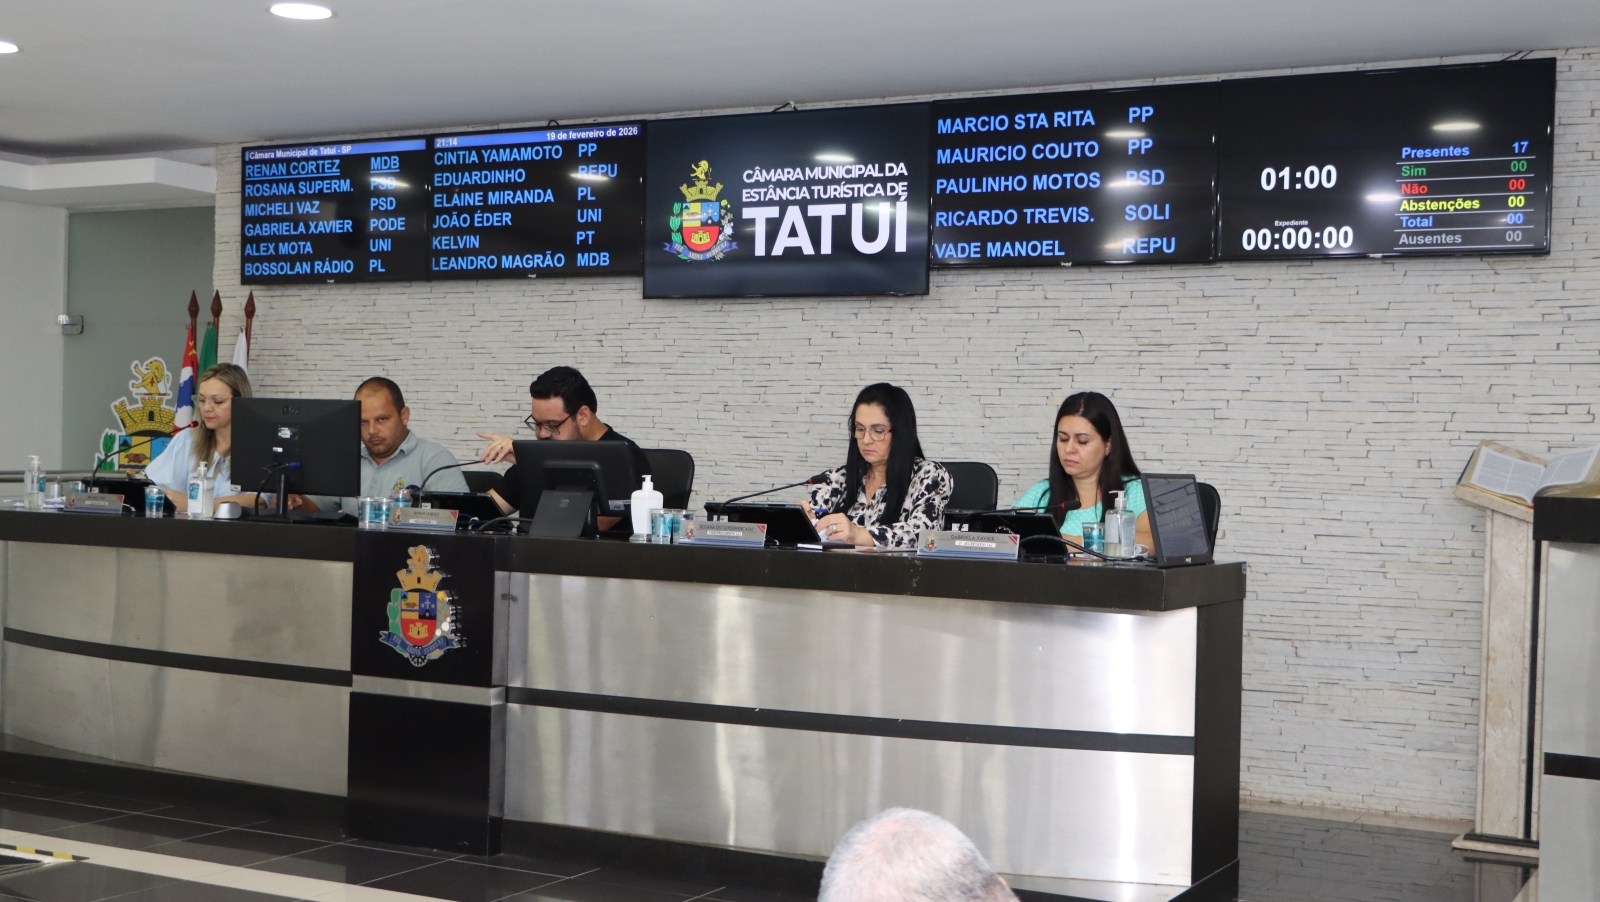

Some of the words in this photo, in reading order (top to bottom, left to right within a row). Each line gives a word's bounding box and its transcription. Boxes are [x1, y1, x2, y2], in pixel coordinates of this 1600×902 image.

[938, 114, 1008, 134] MARCIO
[1014, 113, 1048, 130] STA
[1054, 110, 1095, 128] RITA
[1128, 106, 1154, 123] PP
[436, 138, 458, 146] 21:14
[546, 132, 556, 140] 19
[558, 131, 568, 140] de
[569, 129, 604, 139] fevereiro
[606, 128, 616, 136] de
[618, 127, 638, 136] 2026
[250, 151, 274, 160] Câmara
[276, 148, 308, 158] Municipal
[342, 146, 352, 154] SP
[434, 151, 478, 165] CINTIA
[482, 145, 562, 162] YAMAMOTO
[578, 144, 597, 157] PP
[936, 145, 1026, 164] MAURICIO
[1032, 142, 1098, 160] COUTO
[1128, 138, 1153, 154] PP
[1402, 146, 1470, 158] Presentes
[1512, 142, 1528, 153] 17
[246, 163, 286, 178] RENAN
[290, 160, 340, 174] CORTEZ
[371, 156, 400, 170] MDB
[434, 168, 526, 186] EDUARDINHO
[578, 164, 618, 178] REPU
[743, 166, 803, 182] CÂMARA
[806, 164, 884, 180] MUNICIPAL
[886, 162, 908, 176] DA
[1402, 166, 1426, 176] Sim
[1510, 160, 1527, 172] 00
[246, 183, 296, 196] ROSANA
[298, 179, 354, 194] SUPERM.
[370, 176, 396, 190] PSD
[936, 176, 1027, 194] PAULINHO
[1033, 172, 1100, 190] MOTOS
[1126, 170, 1164, 186] PSD
[1260, 165, 1336, 190] 01:00
[1402, 184, 1428, 194] Não
[1509, 179, 1526, 190] 00
[434, 192, 483, 207] ELAINE
[488, 189, 554, 205] MIRANDA
[578, 187, 596, 200] PL
[742, 184, 810, 202] ESTÂNCIA
[812, 181, 884, 199] TURÍSTICA
[886, 182, 908, 196] DE
[245, 202, 294, 216] MICHELI
[296, 201, 320, 214] VAZ
[370, 198, 396, 210] PSD
[1400, 198, 1480, 212] Abstenções
[1508, 196, 1524, 208] 00
[432, 212, 470, 228] JOÃO
[474, 210, 512, 226] ÉDER
[578, 209, 602, 222] UNI
[936, 209, 1018, 226] RICARDO
[1024, 206, 1094, 224] TREVIS.
[1125, 204, 1170, 220] SOLI
[1400, 216, 1432, 228] Total
[1507, 214, 1524, 224] 00
[245, 223, 306, 236] GABRIELA
[308, 220, 352, 234] XAVIER
[370, 218, 406, 231] PODE
[742, 196, 908, 256] TATUÍ
[432, 236, 480, 250] KELVIN
[577, 231, 595, 245] PT
[1242, 226, 1354, 250] 00:00:00
[1399, 234, 1462, 244] Ausentes
[1506, 231, 1522, 242] 00
[244, 243, 275, 256] ALEX
[279, 242, 312, 254] MOTA
[370, 239, 392, 252] UNI
[935, 243, 980, 258] VADE
[986, 241, 1065, 257] MANOEL
[1123, 238, 1176, 254] REPU
[244, 262, 310, 276] BOSSOLAN
[314, 258, 354, 274] RÁDIO
[370, 260, 386, 272] PL
[432, 256, 498, 270] LEANDRO
[502, 251, 565, 268] MAGRÃO
[577, 252, 610, 266] MDB
